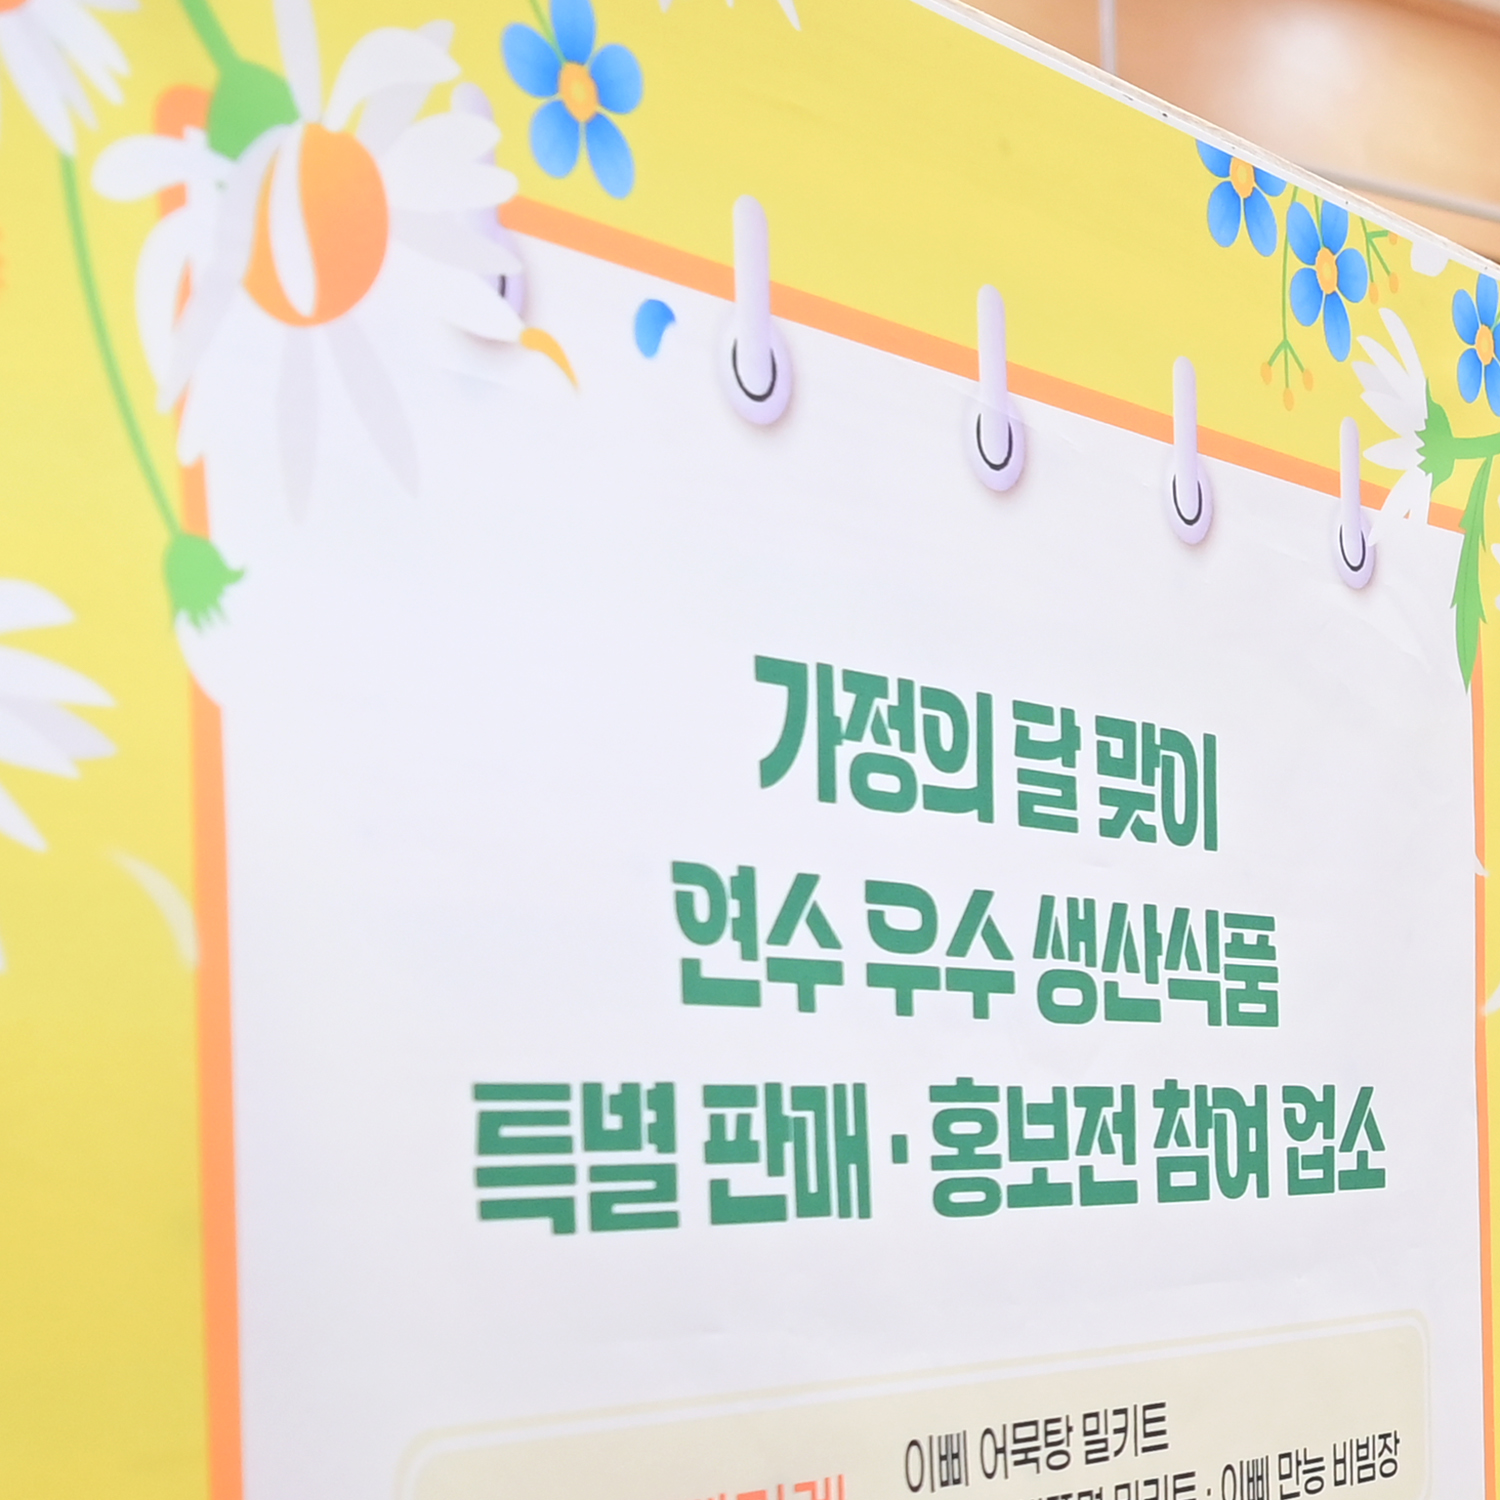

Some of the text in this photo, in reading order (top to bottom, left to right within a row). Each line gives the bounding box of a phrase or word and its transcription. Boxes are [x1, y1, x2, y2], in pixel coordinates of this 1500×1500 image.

[753, 654, 1218, 852] 가정의 달 맞이
[670, 860, 1279, 1028] 연수 우수 생산식품
[471, 1081, 680, 1236] 특별
[702, 1081, 872, 1226] 판매
[928, 1076, 1139, 1218] 홍보전
[1152, 1078, 1270, 1204] 참여
[1281, 1084, 1386, 1197] 업소
[904, 1401, 1170, 1494] 이삐 어묵탕 밀키트
[1332, 1429, 1401, 1488] 비빔장
